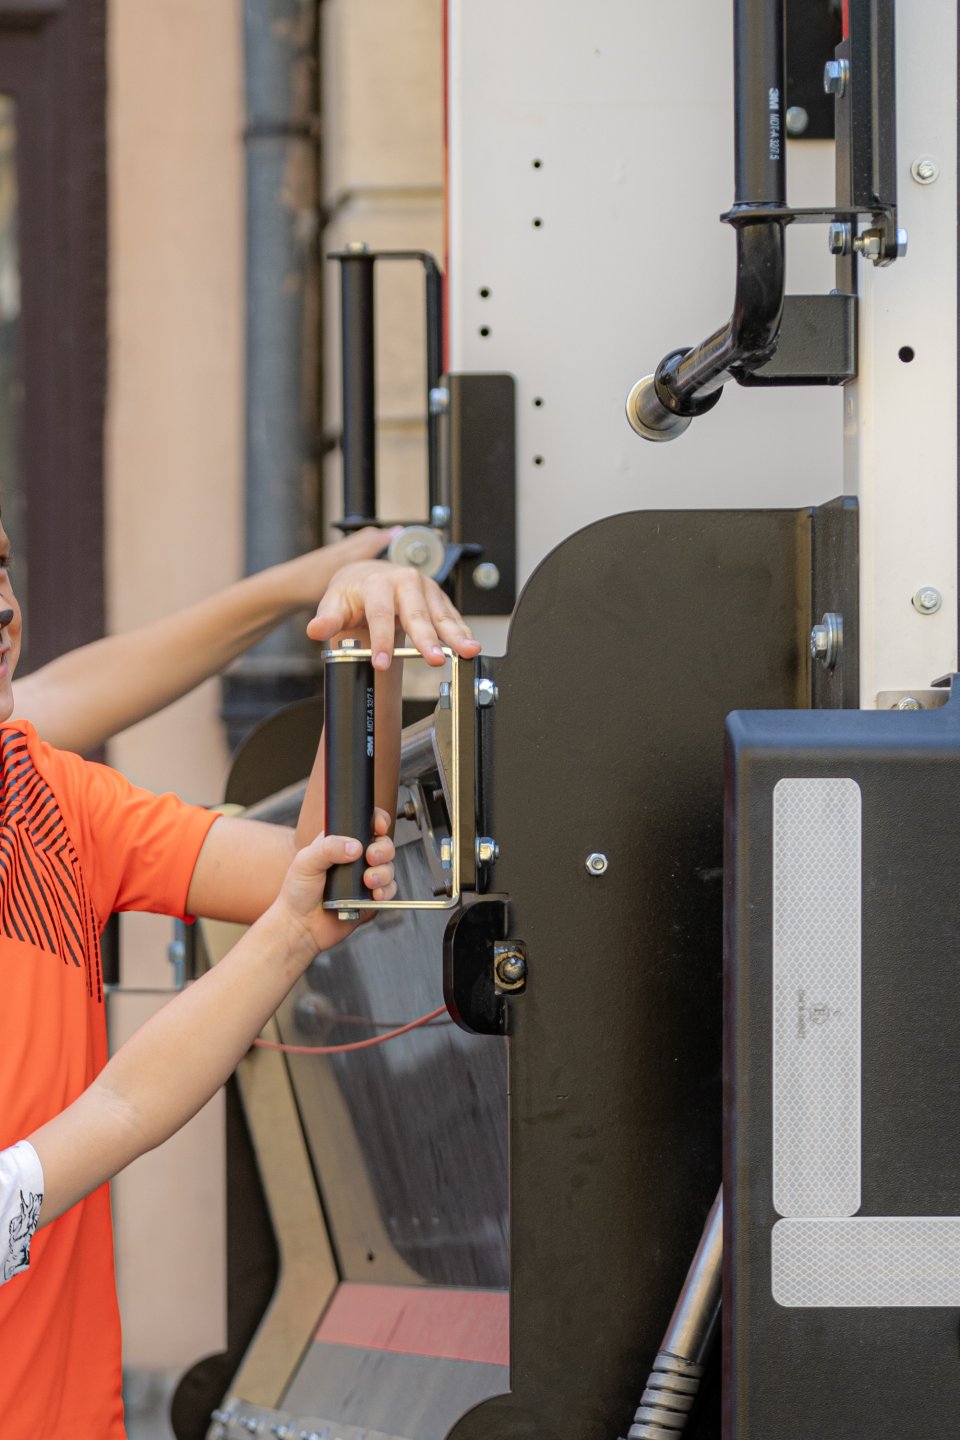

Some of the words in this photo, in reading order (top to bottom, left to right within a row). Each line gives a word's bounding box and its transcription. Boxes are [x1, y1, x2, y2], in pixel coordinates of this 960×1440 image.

[769, 87, 779, 109] 3M
[770, 113, 780, 138] MDT-A
[366, 709, 374, 732] MDT-A
[366, 736, 374, 757] 3M
